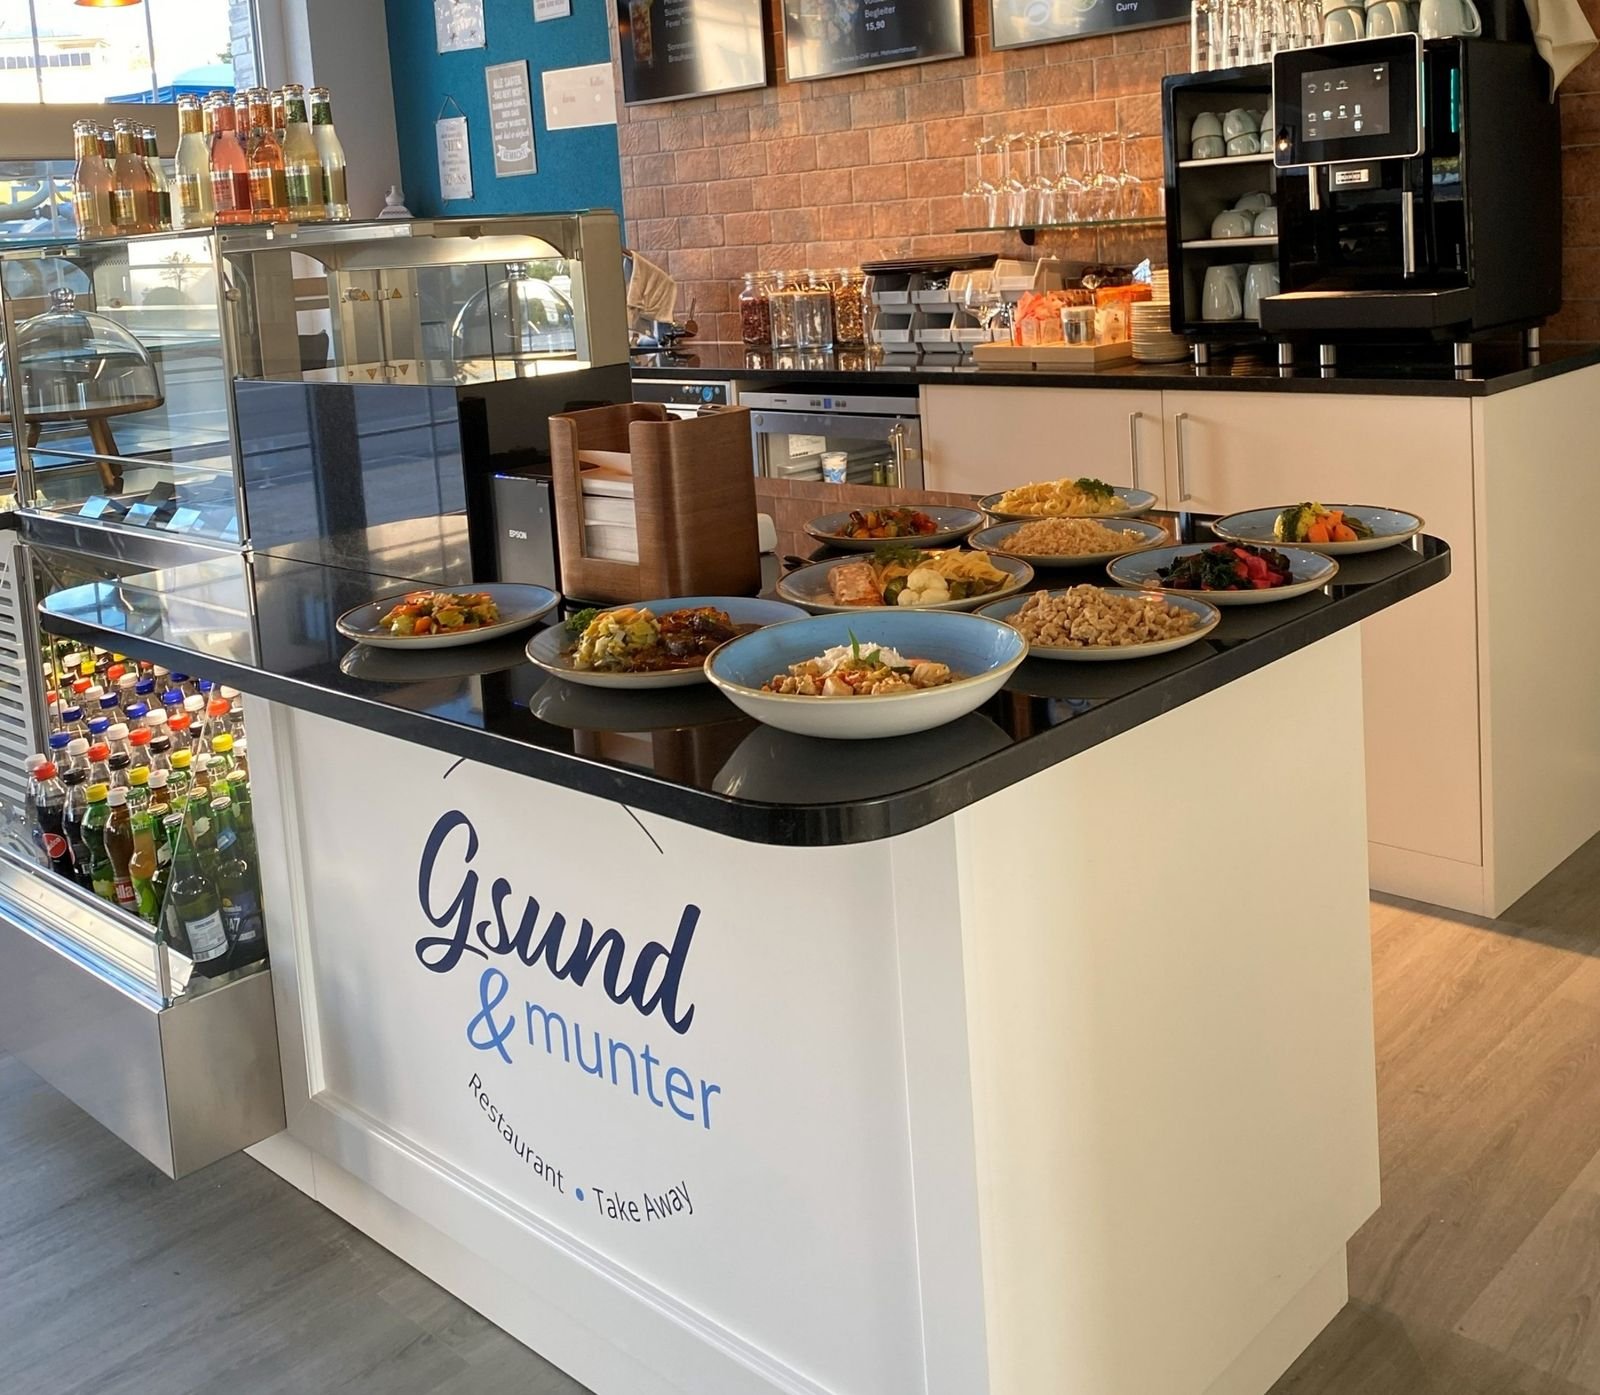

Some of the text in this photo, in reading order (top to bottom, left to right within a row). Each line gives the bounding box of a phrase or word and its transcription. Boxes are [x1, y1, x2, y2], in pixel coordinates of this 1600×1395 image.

[864, 6, 896, 19] Begleiter
[1115, 2, 1138, 12] Curry
[864, 20, 886, 31] 15,90
[509, 529, 527, 539] EPSON
[415, 810, 701, 1034] Gsund
[467, 967, 721, 1129] & munter
[469, 1073, 694, 1222] Restaurant Take Away
